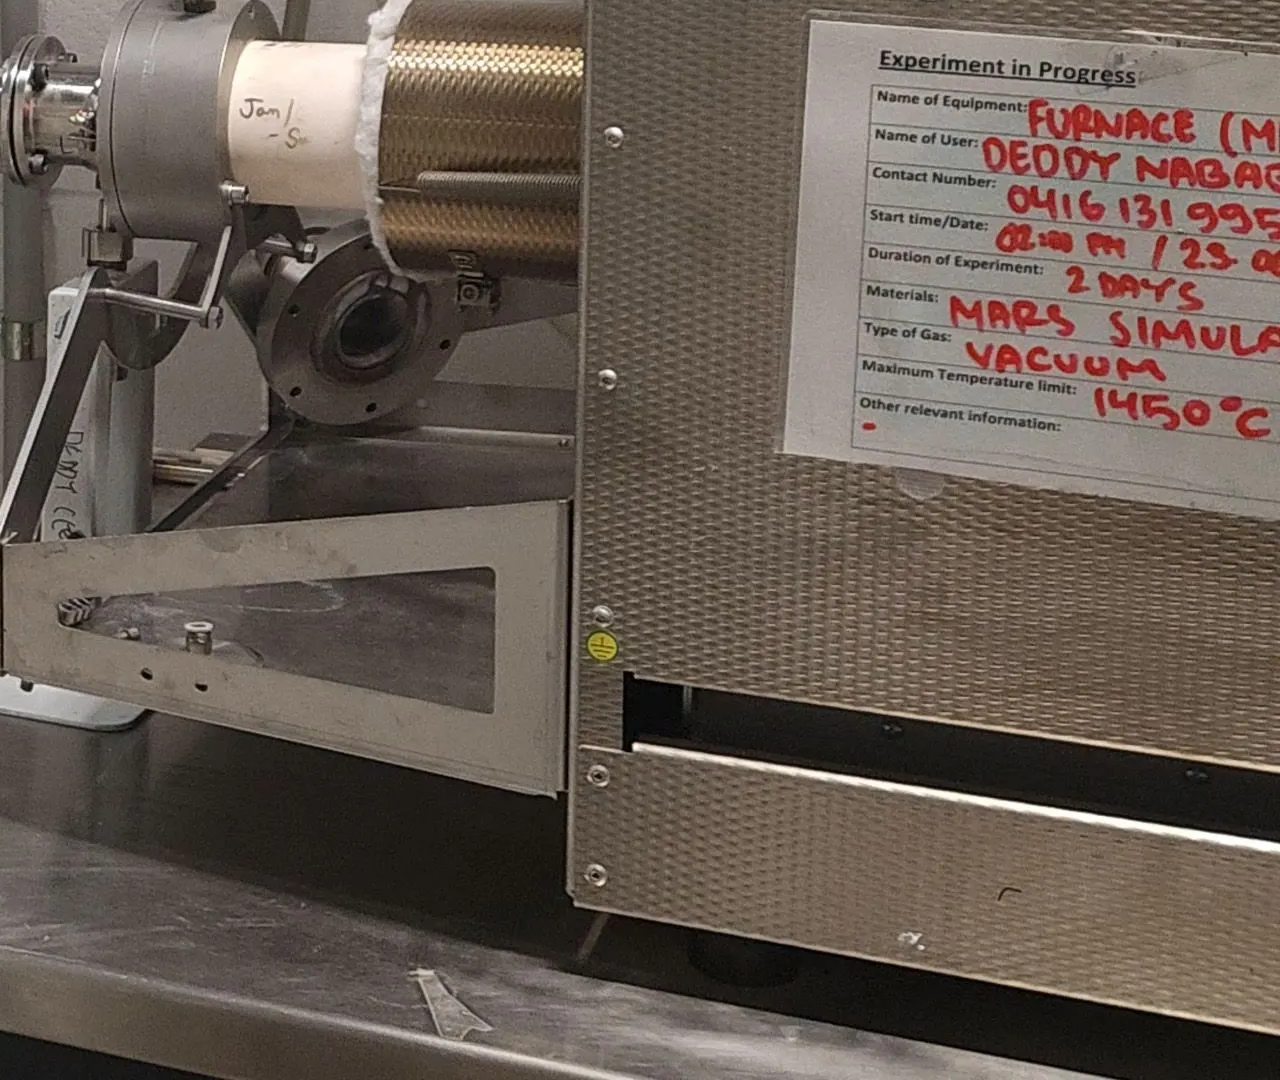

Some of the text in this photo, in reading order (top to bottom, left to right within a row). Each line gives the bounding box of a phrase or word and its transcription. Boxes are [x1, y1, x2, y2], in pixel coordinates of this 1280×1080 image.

[879, 50, 1136, 85] Experiment in Progress
[878, 91, 1027, 112] Name of Equipment:
[875, 128, 979, 148] Name of User:
[1028, 97, 1280, 158] FURNACE (M
[982, 136, 1121, 180] DEDDY
[872, 166, 997, 189] Contact Number:
[870, 209, 989, 232] Start time/Date:
[1007, 184, 1106, 221] 0416
[1118, 193, 1173, 230] 131
[868, 247, 1044, 275] Duration of Experiment:
[866, 285, 939, 303] Materials:
[1065, 265, 1205, 311] 2 DAYS
[864, 322, 953, 343] Type of Gas:
[949, 295, 1076, 338] MARS
[862, 360, 1078, 395] Maximum Temperature limit:
[965, 341, 1167, 381] VACUUM
[859, 397, 1062, 432] Other relevant information:
